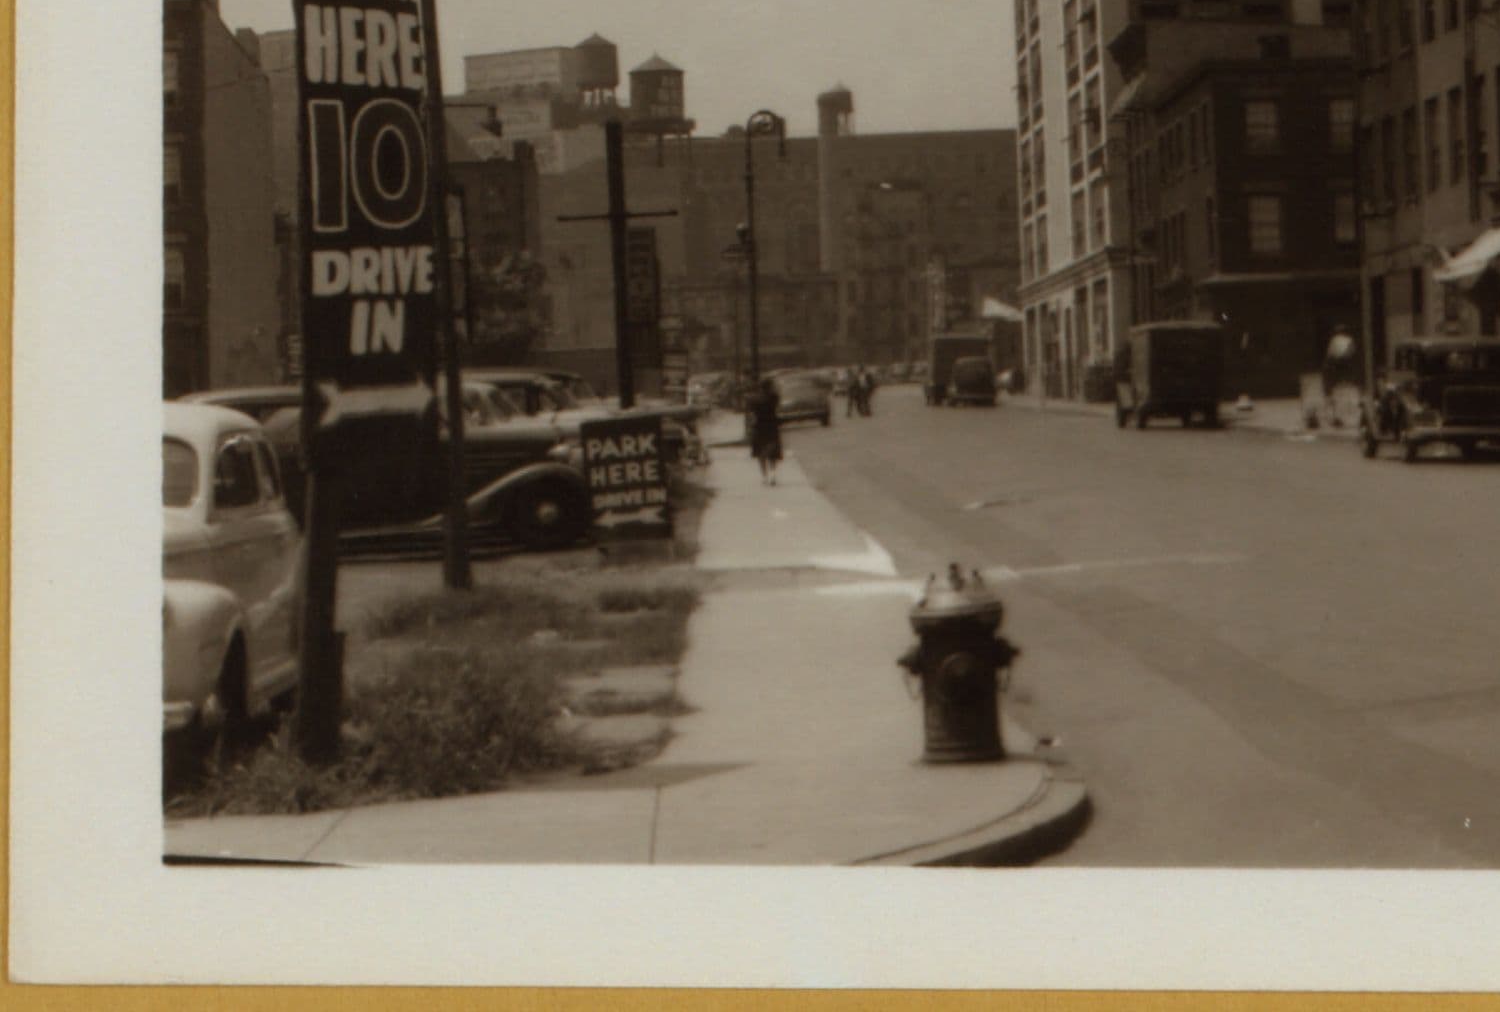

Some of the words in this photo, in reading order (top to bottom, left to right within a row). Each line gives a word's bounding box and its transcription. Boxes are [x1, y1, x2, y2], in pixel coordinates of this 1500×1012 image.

[304, 4, 423, 89] HERE
[311, 246, 433, 296] DRIVE
[350, 300, 405, 355] IN
[587, 434, 657, 461] PARK
[590, 461, 659, 487] HERE
